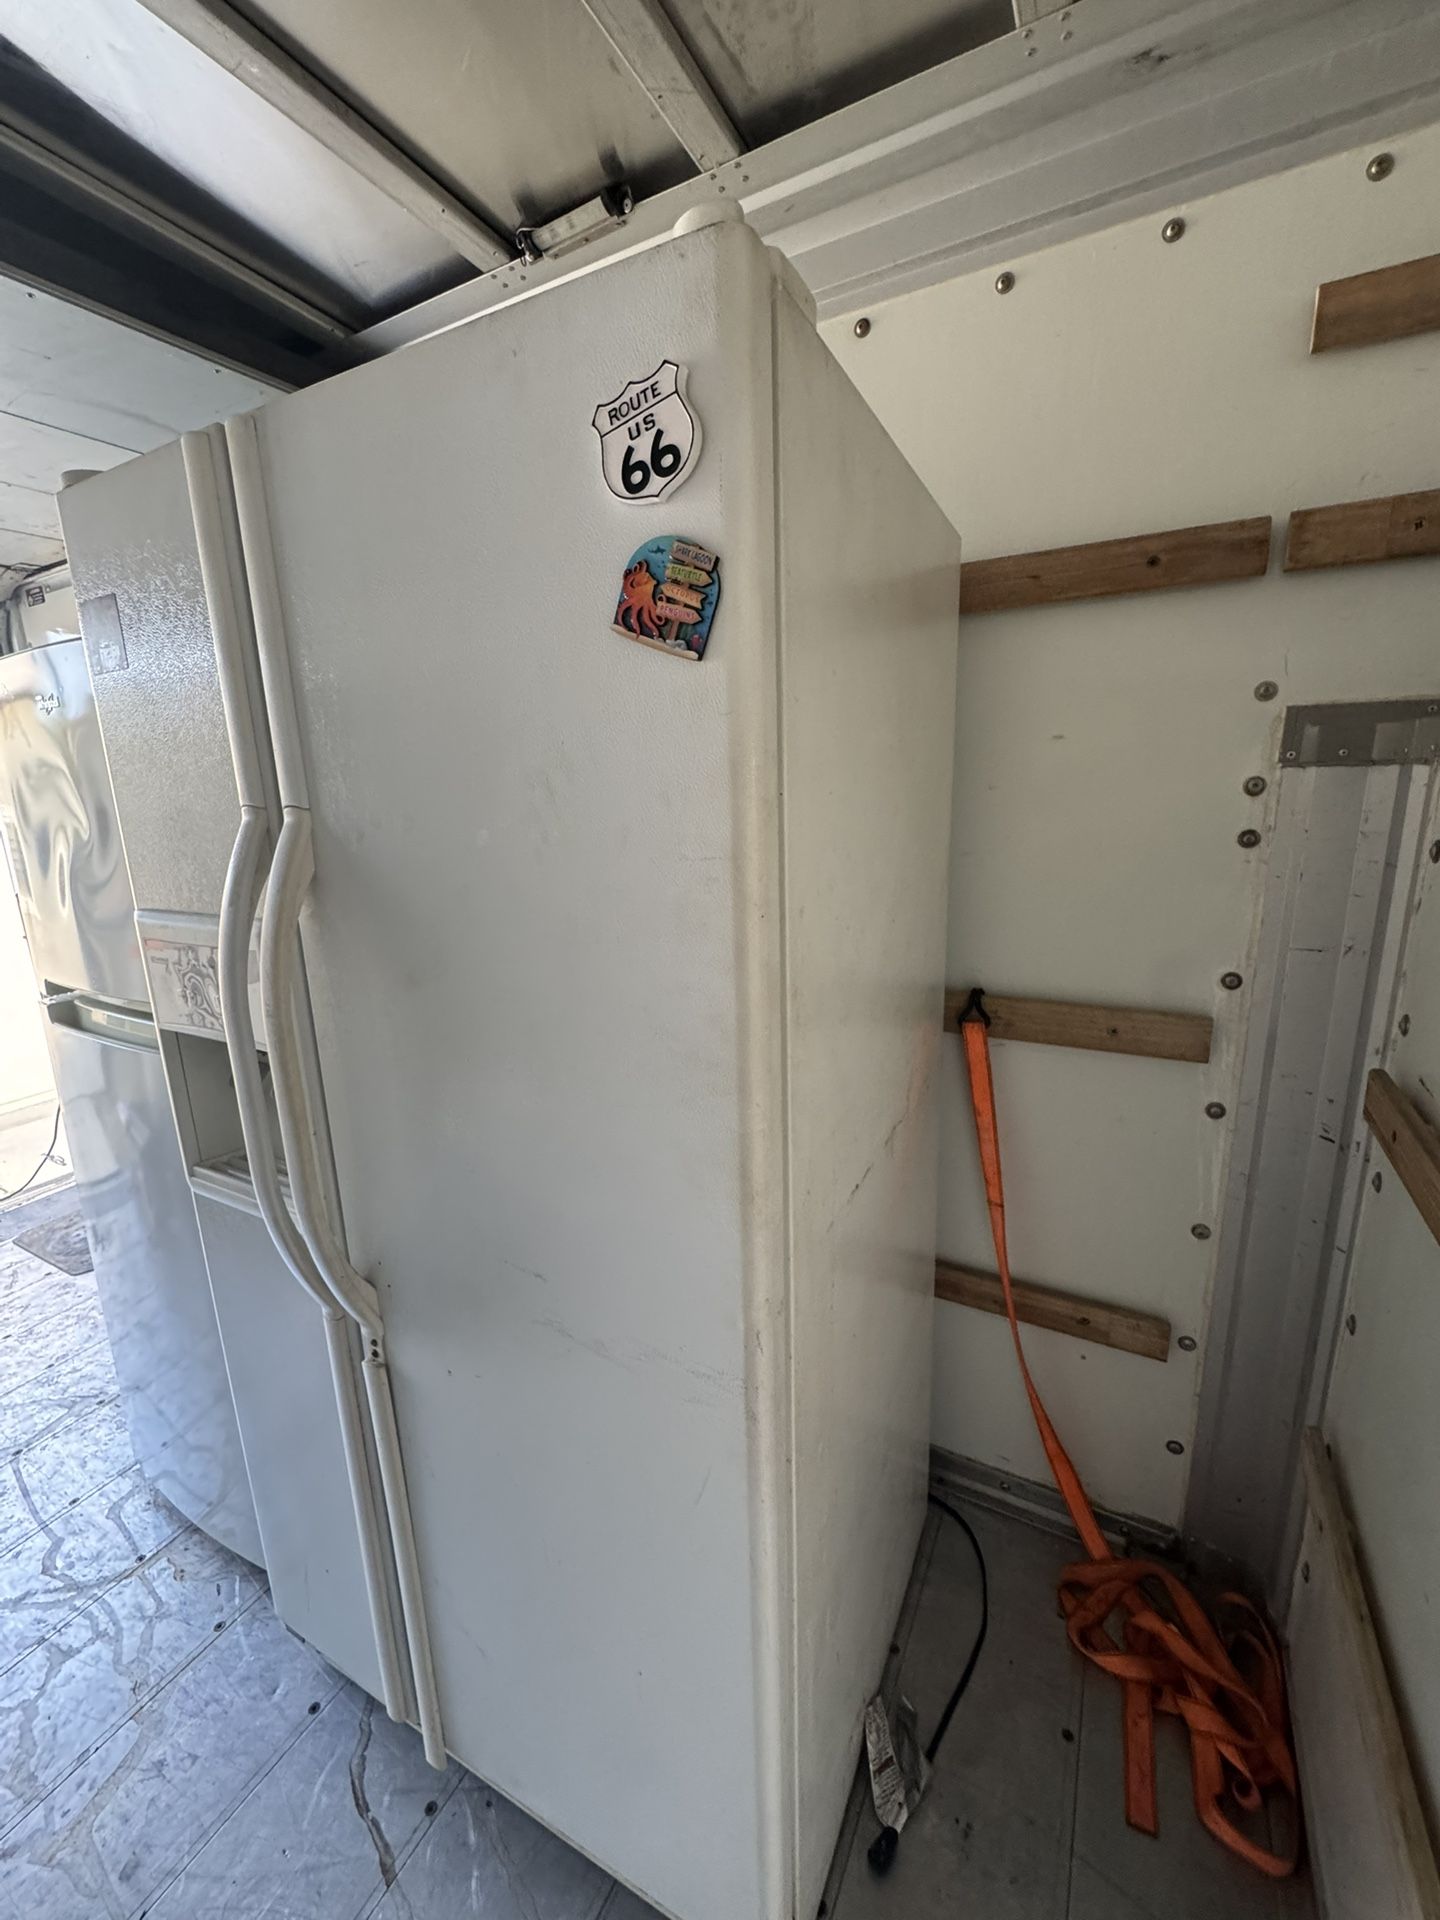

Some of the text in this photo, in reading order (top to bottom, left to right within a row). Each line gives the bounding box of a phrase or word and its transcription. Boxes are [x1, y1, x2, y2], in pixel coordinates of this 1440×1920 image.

[607, 381, 662, 426] ROUTE
[628, 413, 656, 441] US
[621, 428, 681, 494] 66
[665, 585, 699, 602] OCTOPUS
